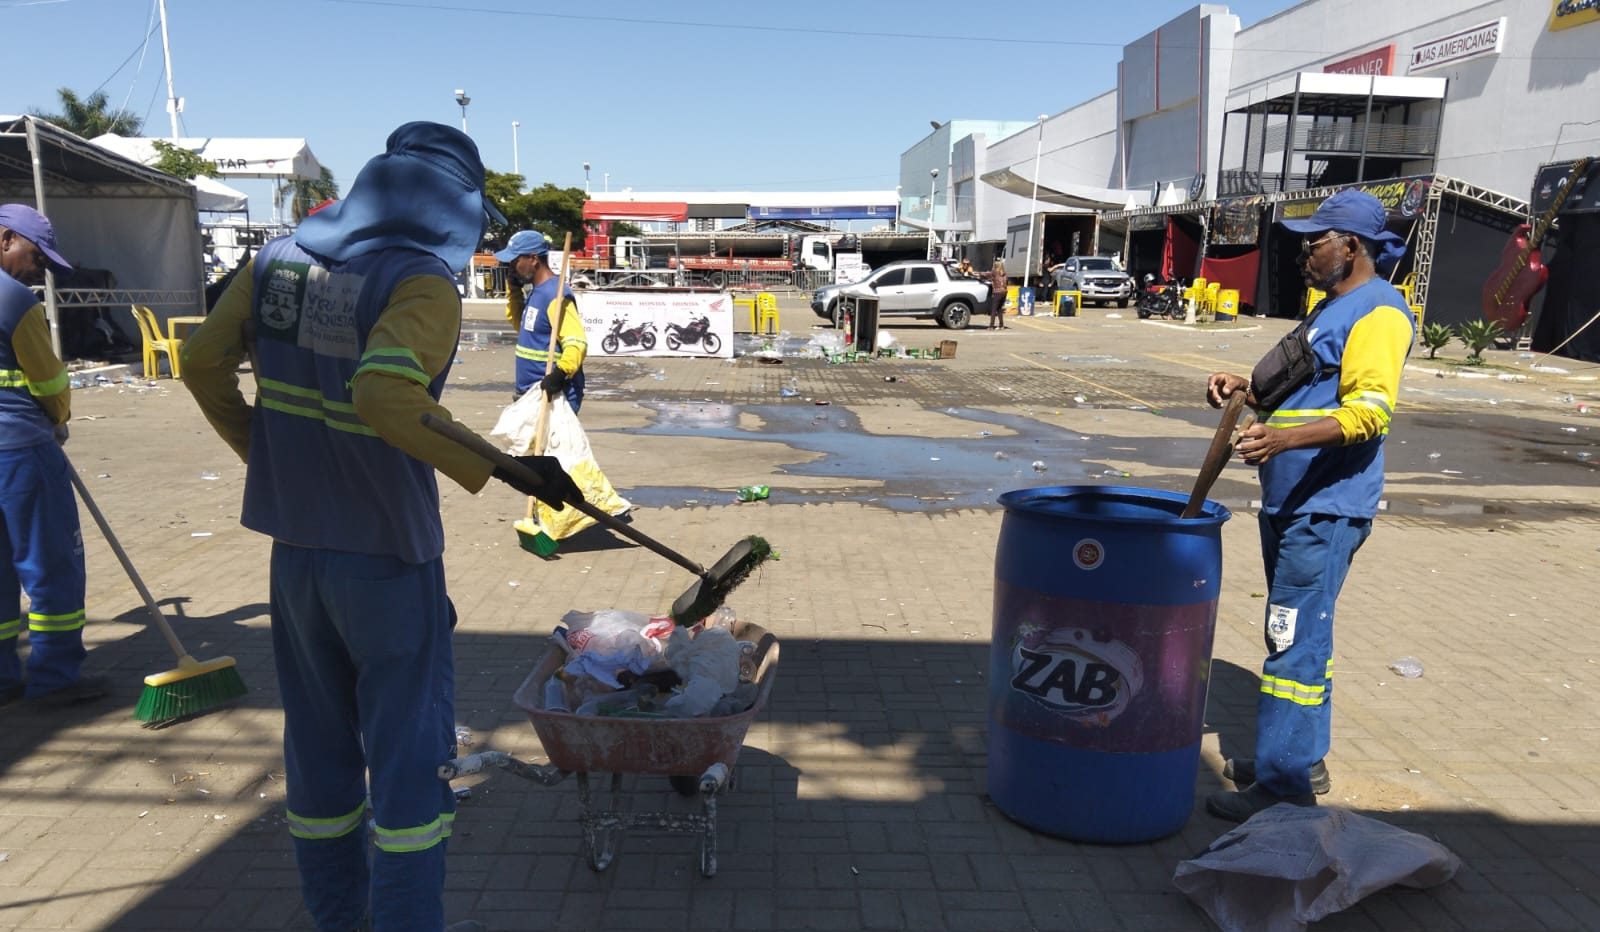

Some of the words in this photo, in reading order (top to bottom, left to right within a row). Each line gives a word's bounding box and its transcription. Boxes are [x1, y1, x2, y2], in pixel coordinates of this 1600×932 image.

[1437, 28, 1499, 58] AMERICANAS
[1340, 58, 1383, 76] NNER
[1011, 647, 1121, 706] ZAB
